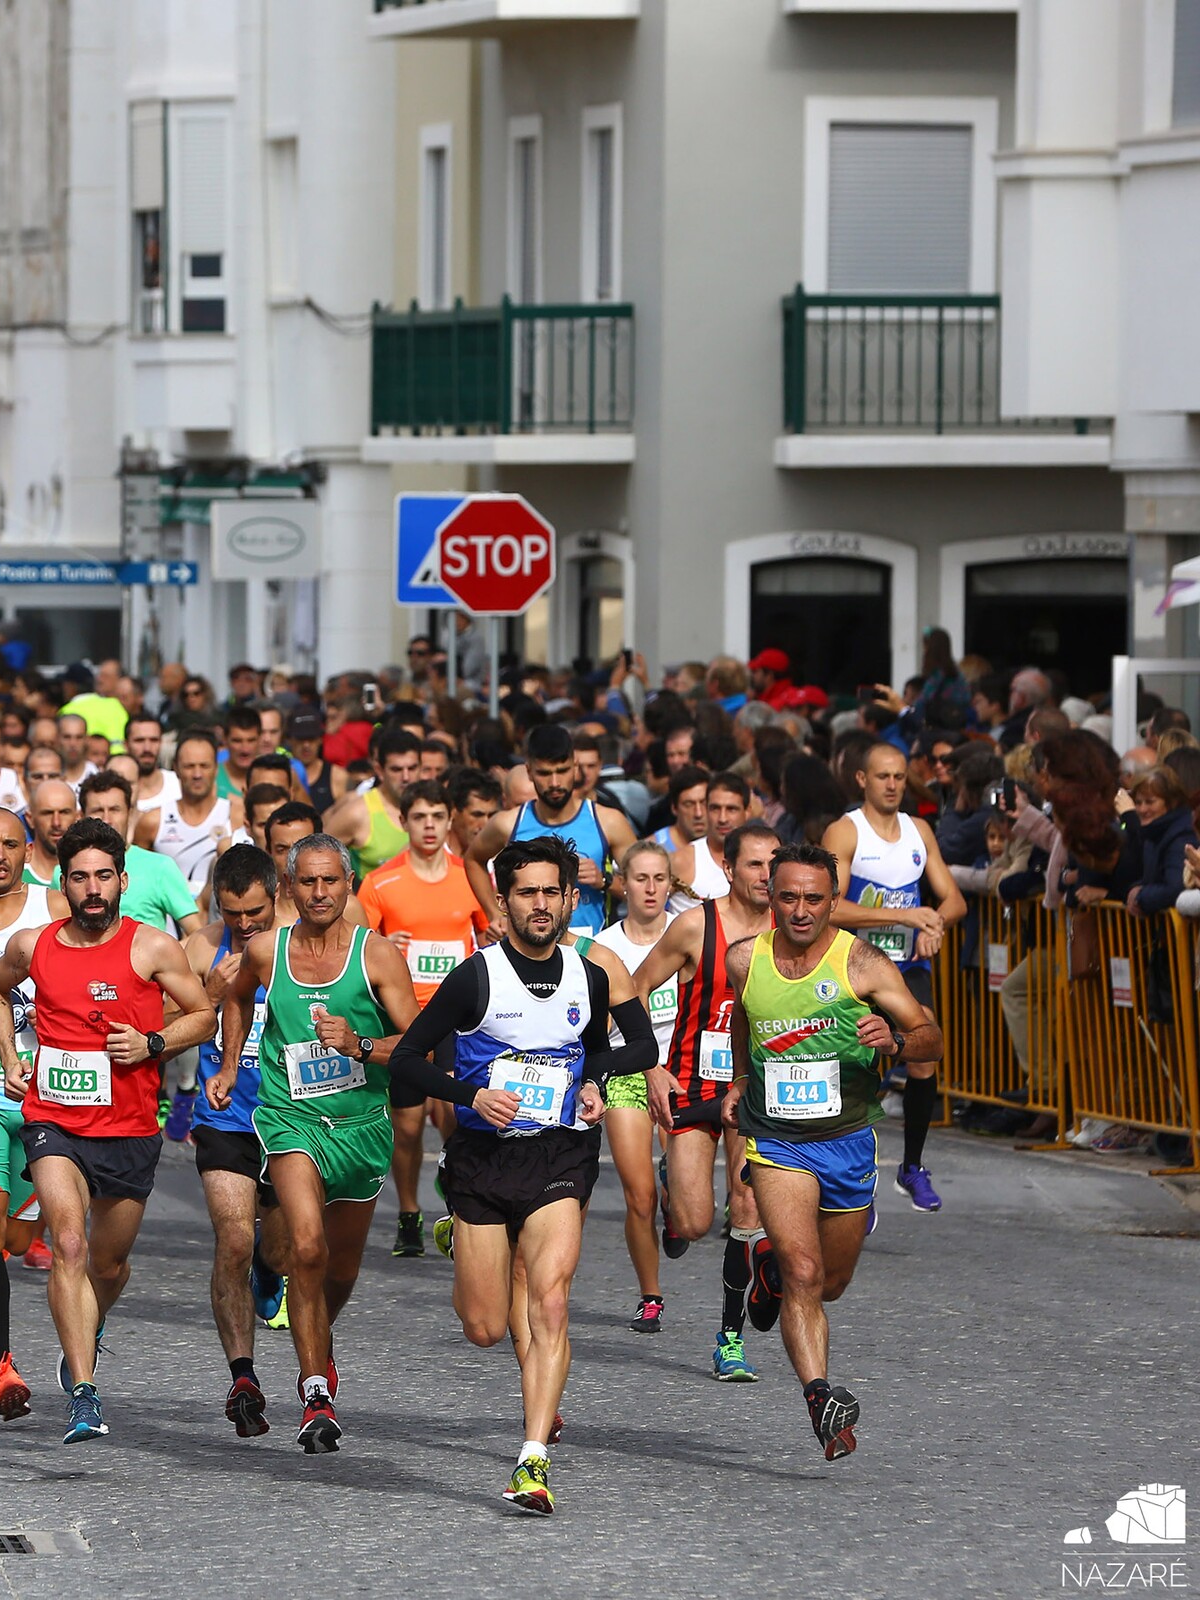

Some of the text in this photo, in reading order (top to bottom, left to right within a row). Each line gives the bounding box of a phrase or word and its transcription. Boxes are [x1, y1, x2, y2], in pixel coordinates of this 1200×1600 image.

[443, 533, 549, 578] STOP
[0, 563, 116, 581] Posto de Turismo
[871, 934, 903, 949] 1248
[420, 958, 454, 971] 1157
[755, 1017, 838, 1034] SERVIPAVI
[765, 1052, 838, 1062] www.servipavi.com
[307, 1059, 341, 1080] 192
[51, 1070, 93, 1090] 1025
[514, 1086, 546, 1107] 685
[785, 1085, 818, 1102] 244
